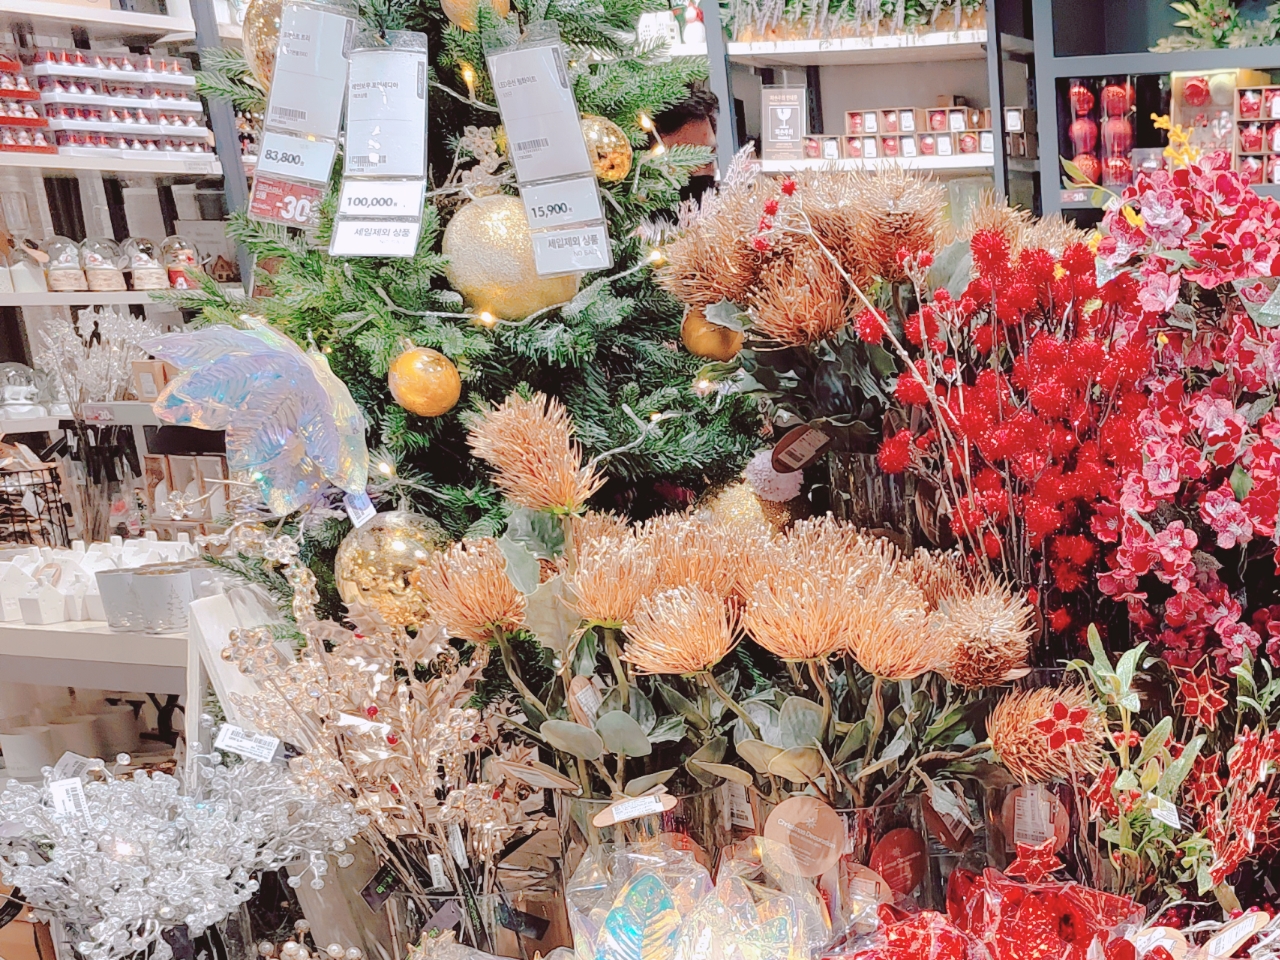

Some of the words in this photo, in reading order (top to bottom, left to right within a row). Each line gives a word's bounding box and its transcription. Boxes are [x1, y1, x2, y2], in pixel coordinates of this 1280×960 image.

[354, 227, 391, 238] 세일제외
[392, 228, 411, 238] 상품
[548, 235, 581, 250] 세일제외
[582, 234, 599, 247] 상품
